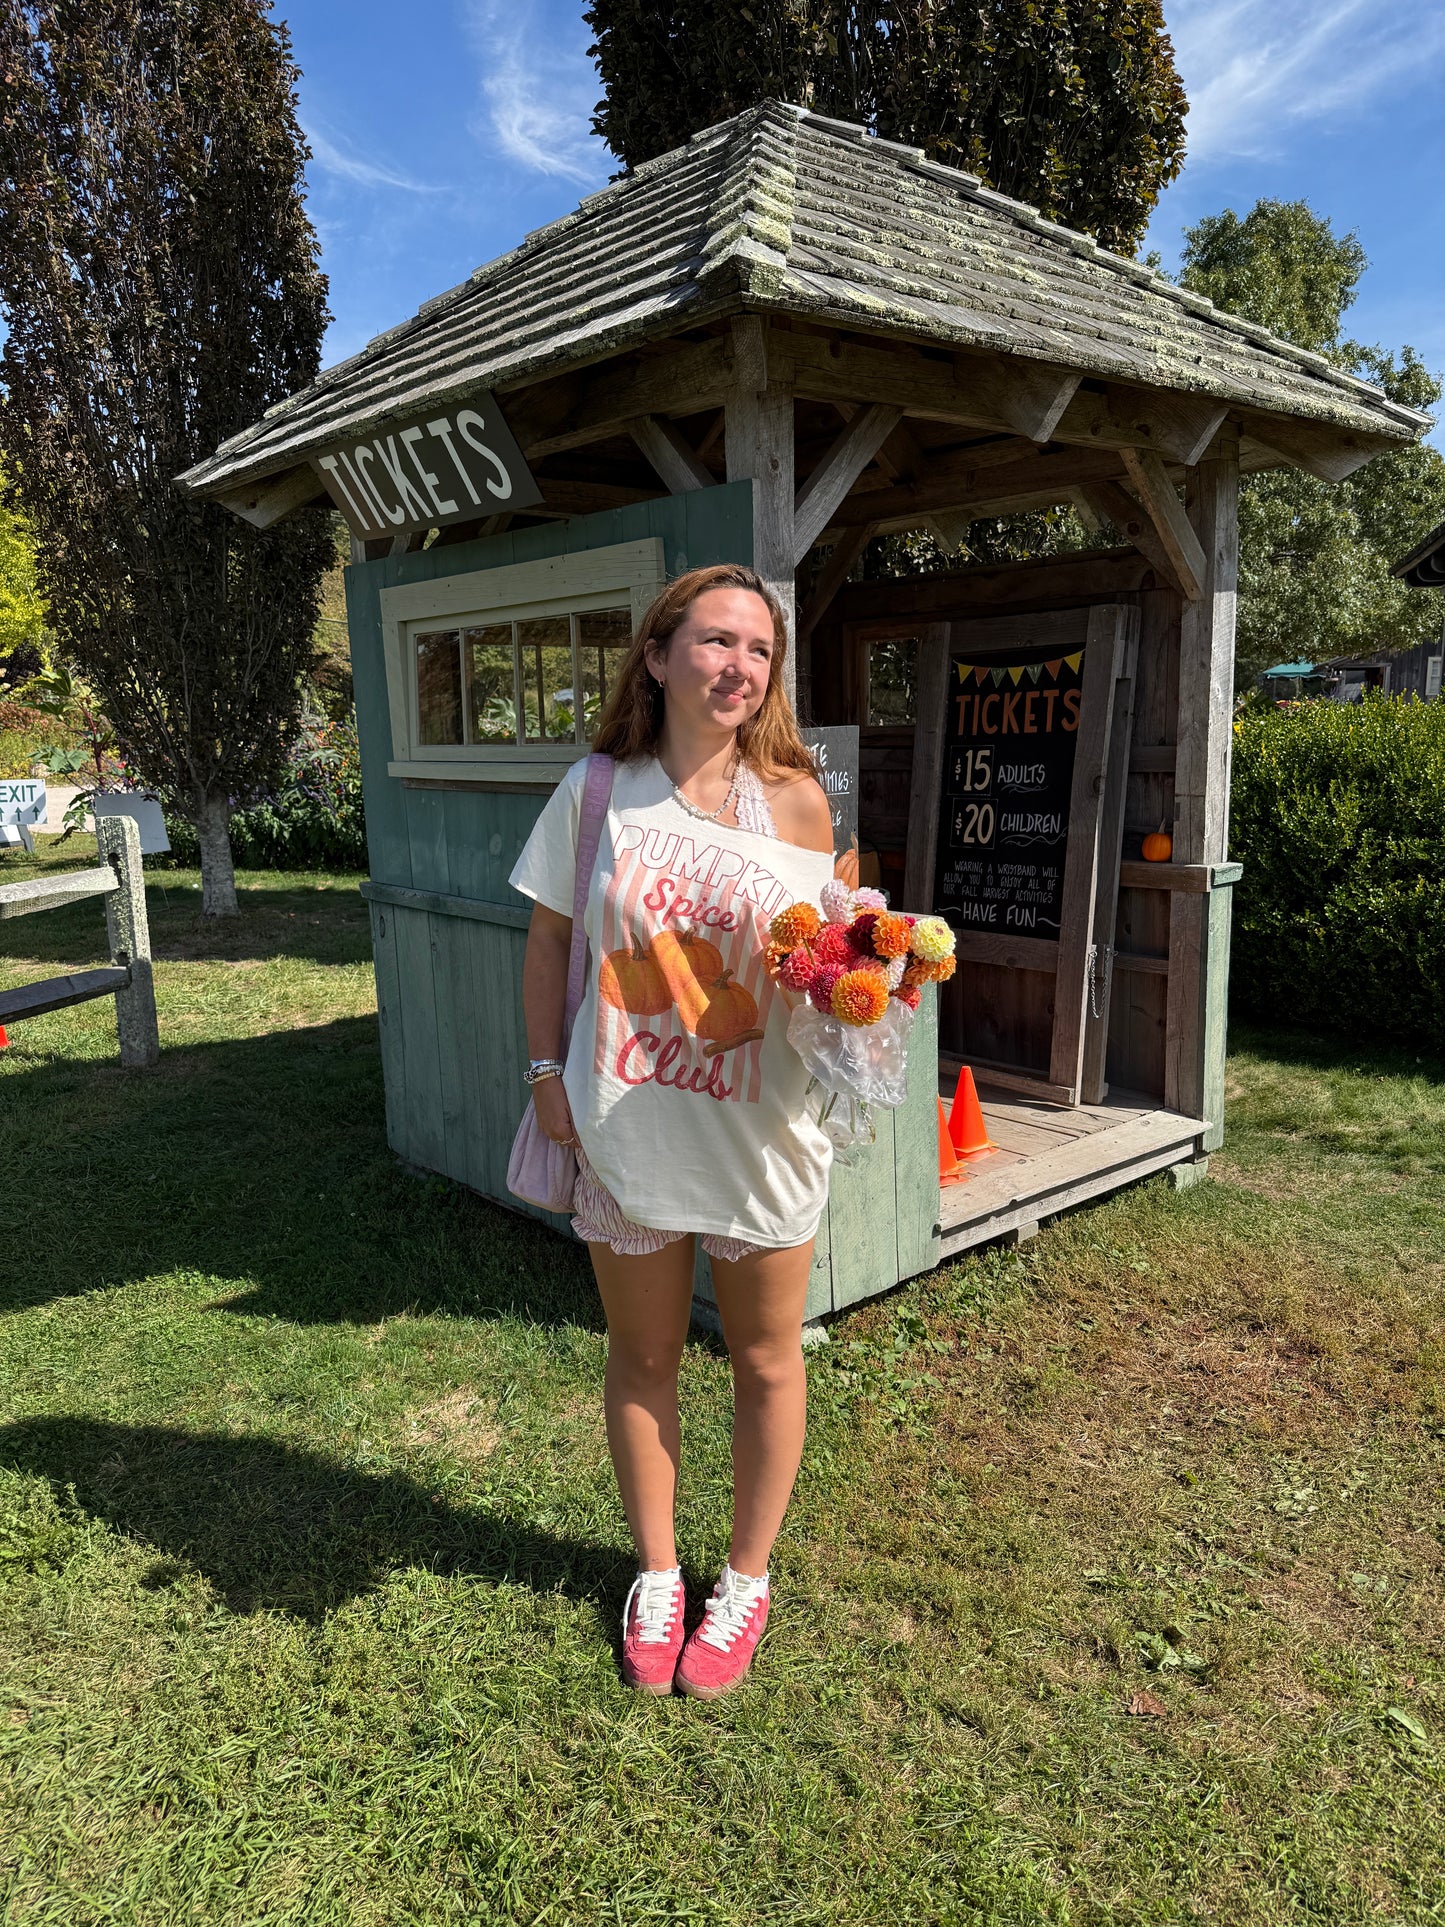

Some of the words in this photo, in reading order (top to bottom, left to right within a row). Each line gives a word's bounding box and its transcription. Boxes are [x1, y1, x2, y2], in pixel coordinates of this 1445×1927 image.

[319, 409, 512, 531] TICKETS
[956, 688, 1081, 736] TICKETS
[997, 764, 1046, 784] ADULTS
[0, 785, 37, 802] EXIT
[1000, 812, 1061, 834] CHILDREN
[954, 860, 983, 874] WEARING
[987, 863, 993, 874] A
[997, 863, 1037, 876] WRISTBAND
[1042, 866, 1059, 878] WILL
[943, 872, 963, 884] ALLOW
[969, 873, 980, 885] YOU
[986, 875, 993, 886] TO
[1000, 875, 1022, 888] ENJOY
[1027, 878, 1040, 890] ALL
[1047, 879, 1056, 891] OF
[943, 883, 956, 895] OUR
[961, 884, 977, 897] FALL
[983, 887, 1011, 899] HARVEST
[1015, 889, 1053, 904] ACTIVITIES
[643, 878, 739, 932] Spice
[963, 901, 997, 923] HAVE
[1006, 904, 1036, 928] FUN
[616, 1030, 734, 1101] Club
